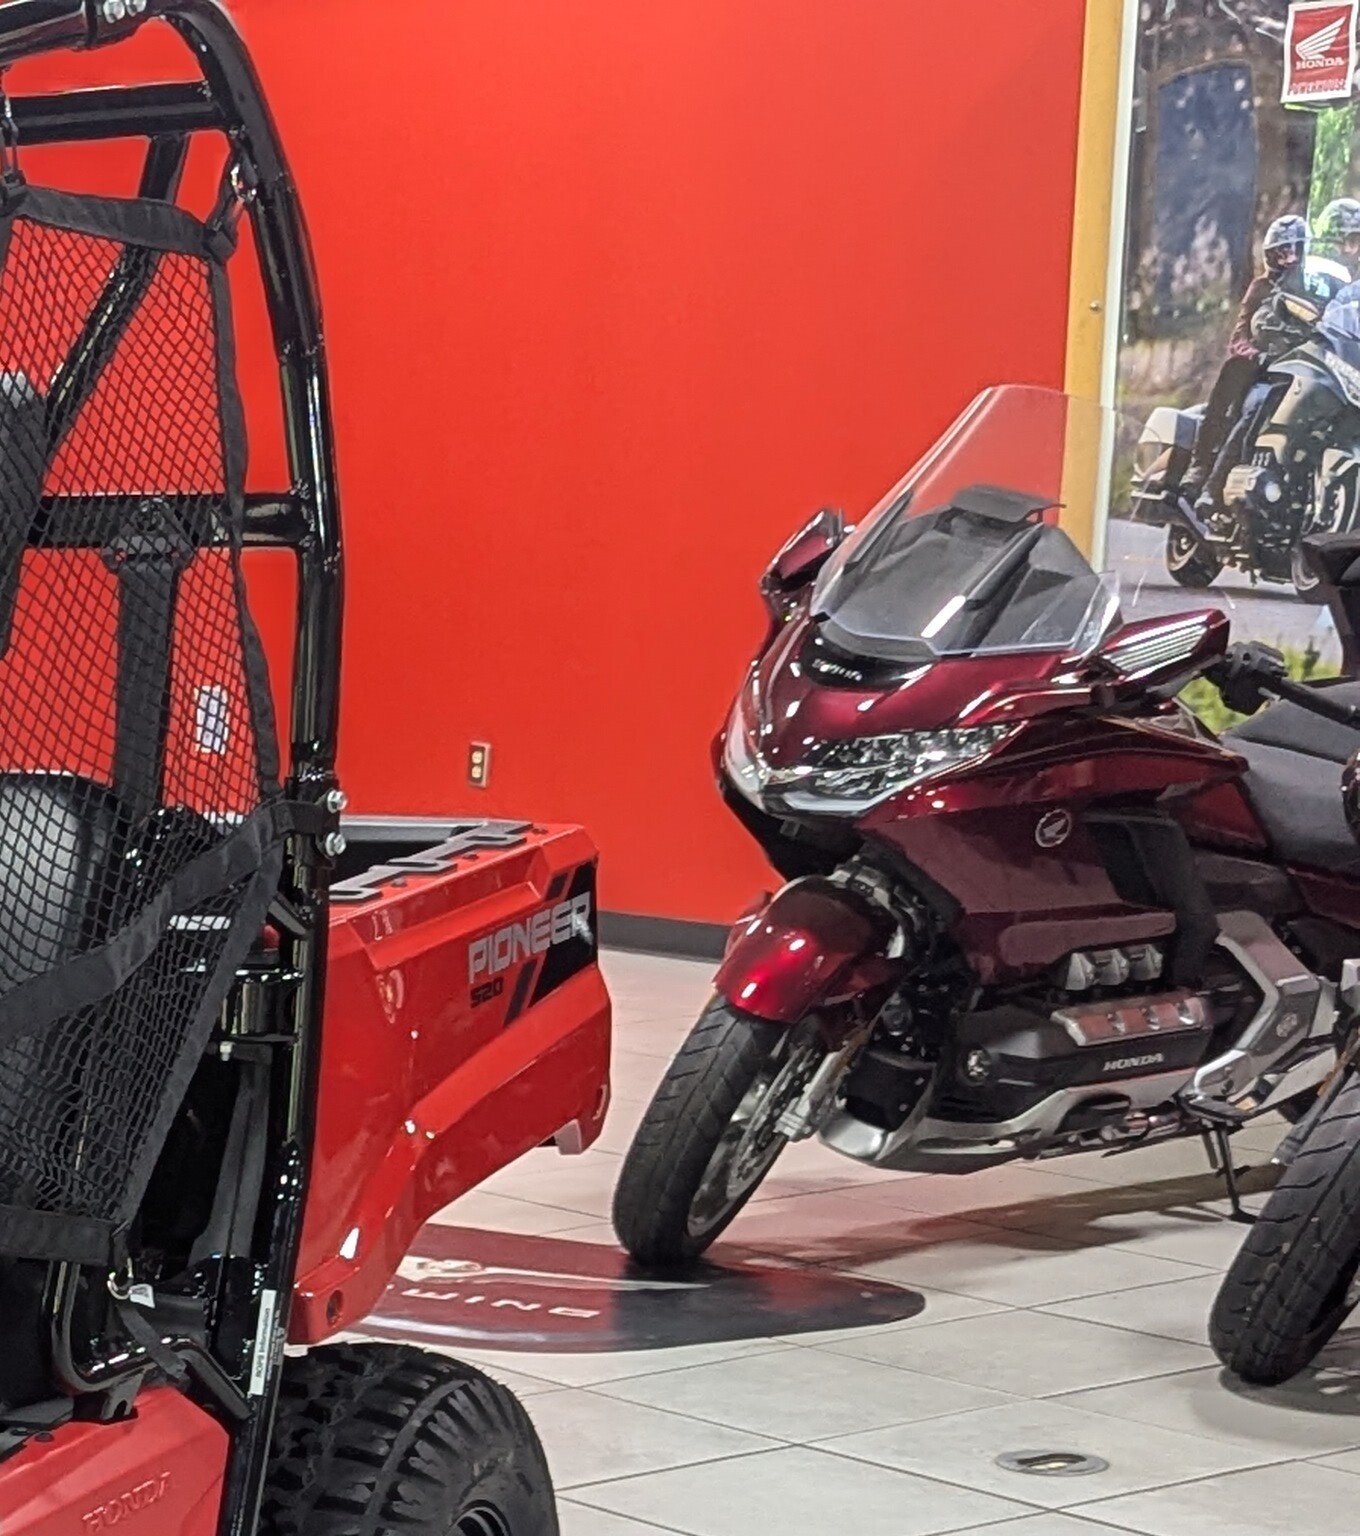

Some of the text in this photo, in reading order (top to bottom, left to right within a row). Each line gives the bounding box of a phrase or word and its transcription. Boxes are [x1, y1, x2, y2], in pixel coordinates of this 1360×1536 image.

[1295, 57, 1345, 70] HONDA
[468, 891, 594, 984] PIONEER
[1103, 1053, 1164, 1071] HONDA
[81, 1471, 170, 1534] HONDA
